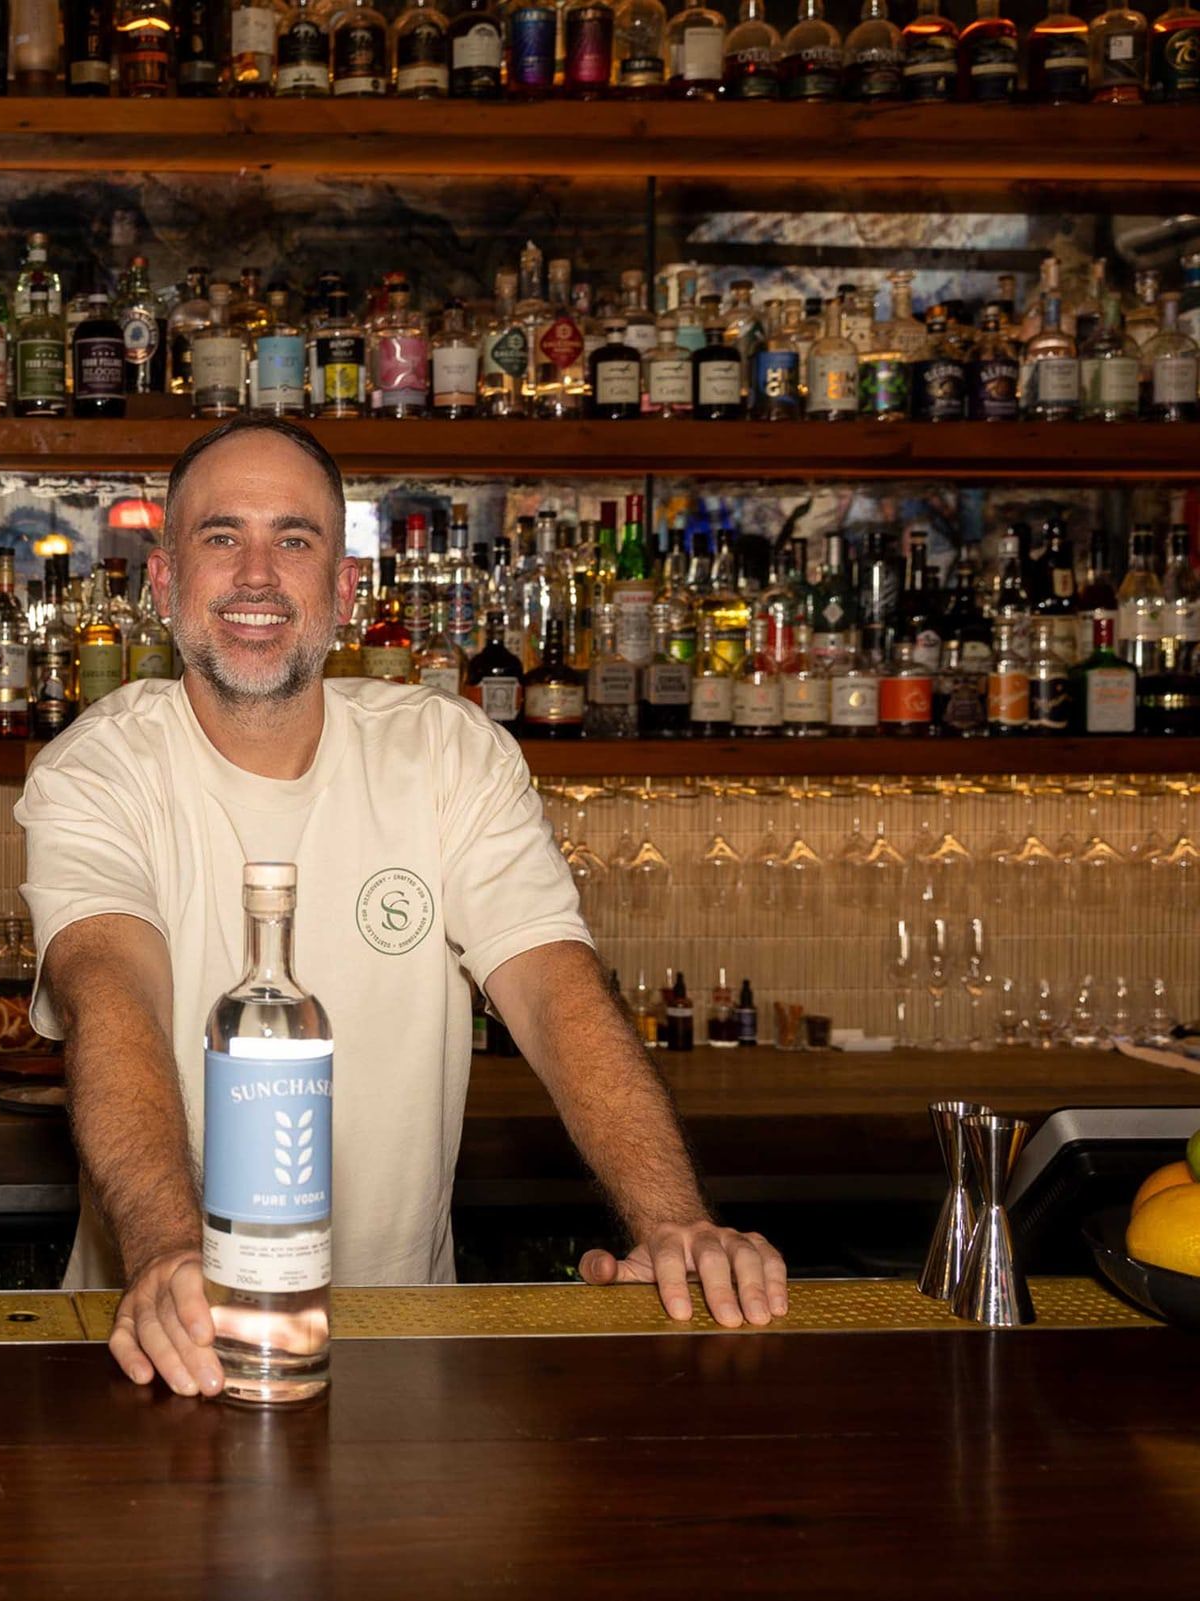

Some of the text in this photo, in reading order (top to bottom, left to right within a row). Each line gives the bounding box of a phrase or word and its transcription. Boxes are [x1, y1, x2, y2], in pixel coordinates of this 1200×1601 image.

[393, 874, 417, 887] CRAFTED
[362, 877, 387, 906] DISCOVERY
[231, 1078, 333, 1104] SUNCHASE
[253, 1191, 326, 1207] PURE VODKA
